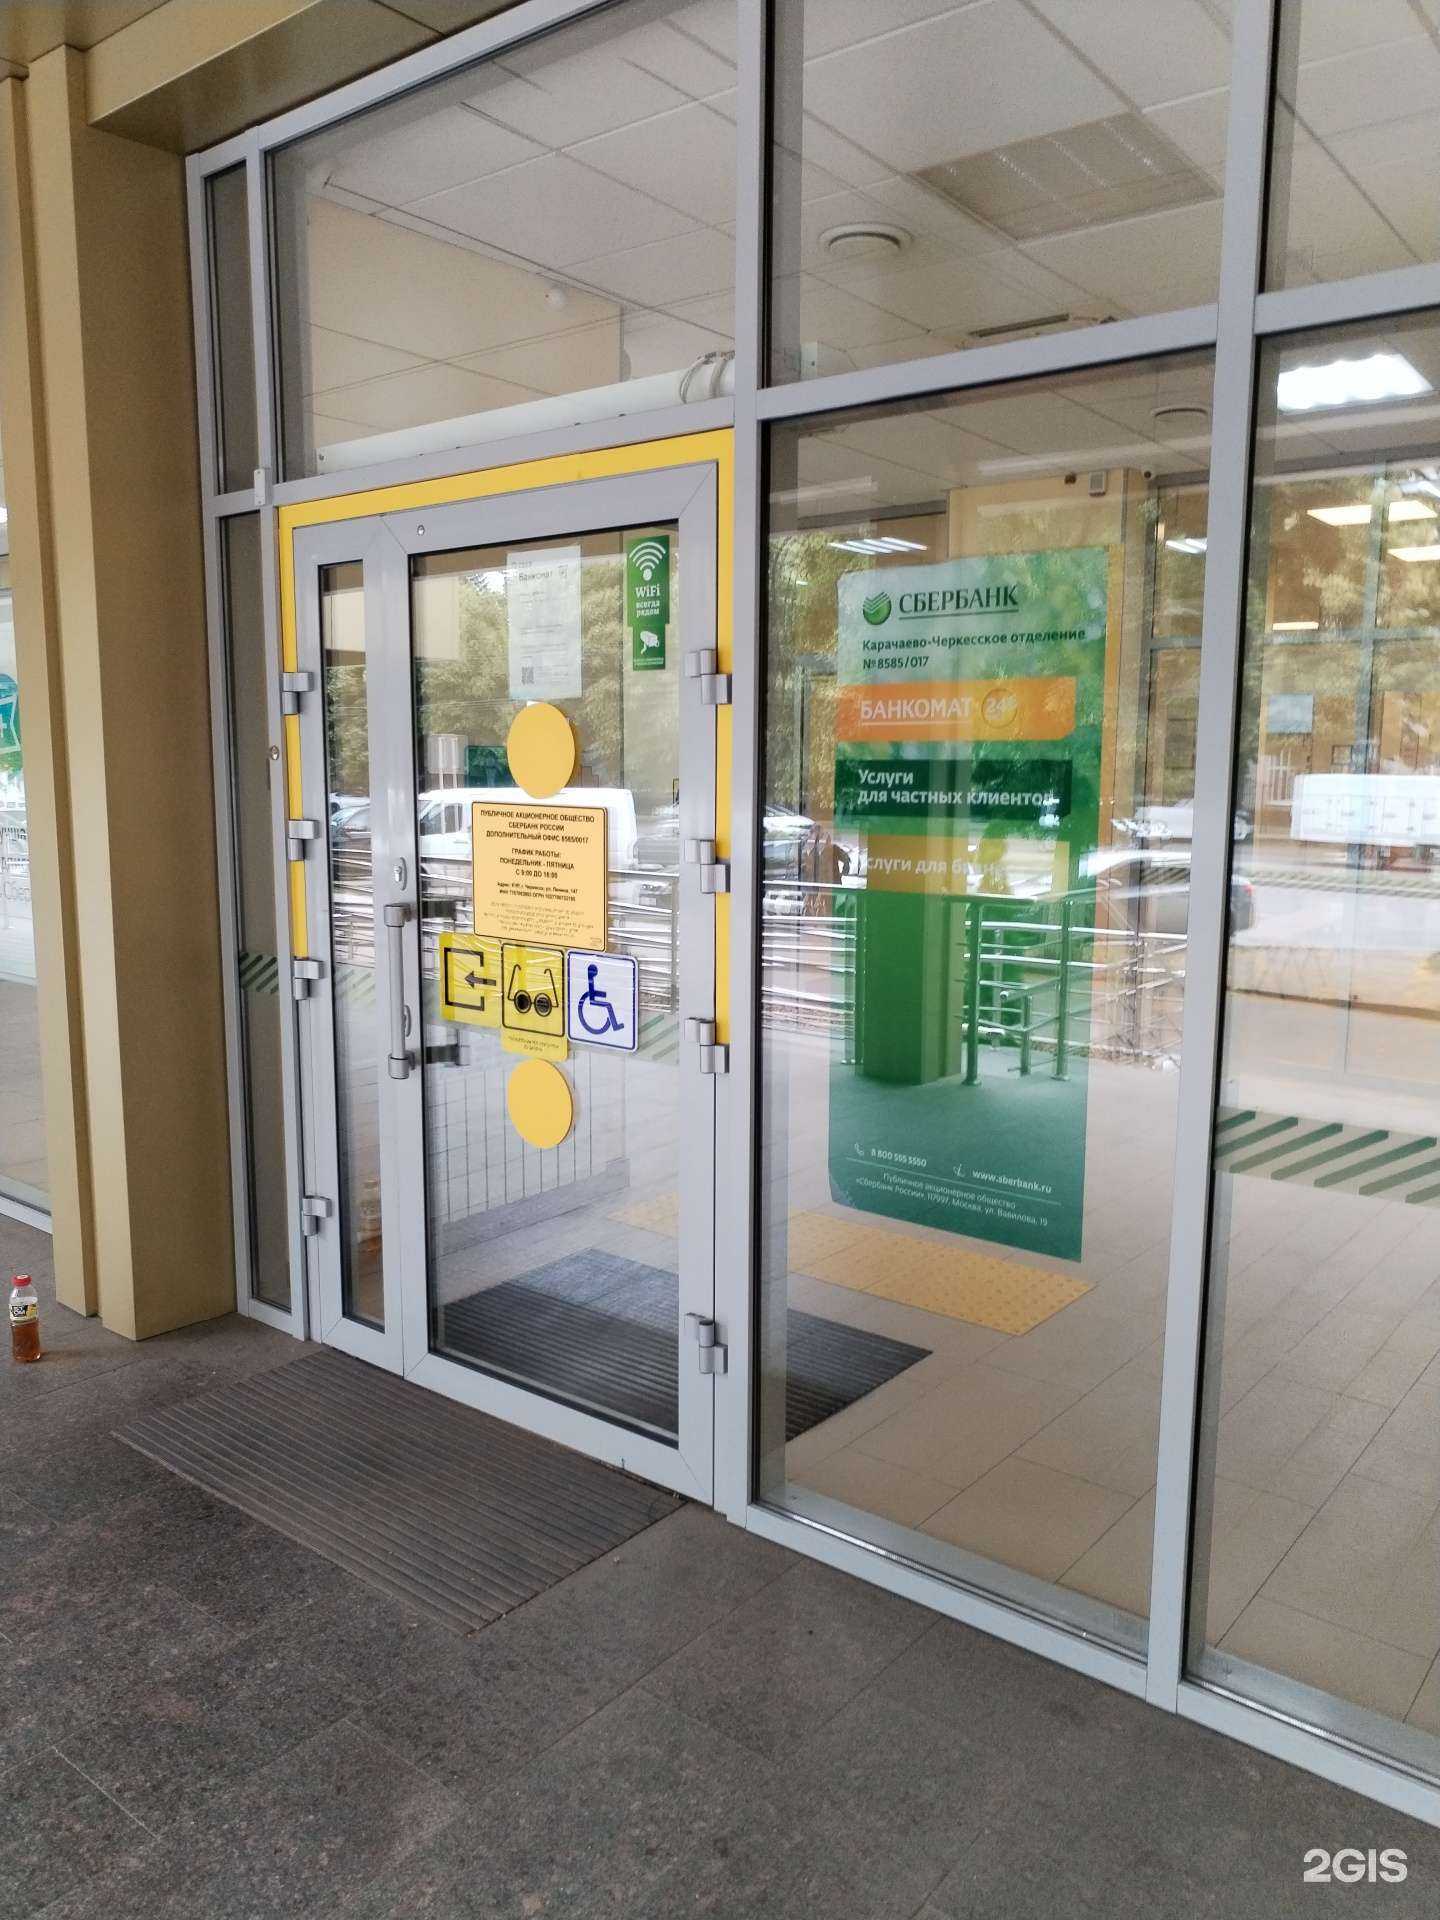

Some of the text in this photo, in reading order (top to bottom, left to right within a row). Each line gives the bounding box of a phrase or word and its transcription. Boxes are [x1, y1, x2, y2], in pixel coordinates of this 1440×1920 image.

[635, 584, 660, 598] WiFi
[898, 585, 1019, 614] СБЕРБАНК
[862, 629, 1086, 652] Карачаево-Черкесское отделение
[860, 697, 973, 720] БАНКОМАТ
[857, 769, 914, 788] Услуги
[857, 789, 888, 806] для
[890, 790, 963, 805] частных
[480, 809, 595, 823] ПУБЛИЧНОЕ АКЦИОНЕРНОЕ ОБЩЕСТВО
[508, 821, 565, 832] СБЕРБАНК РОССИИ
[486, 830, 542, 841] ДОПОЛНИТЕЛЬНЫЙ
[542, 834, 560, 842] ОФИС
[511, 847, 533, 856] ГРАФИК
[499, 857, 542, 867] ПОНЕДЕЛЬНИК
[546, 860, 575, 870] ПЯТНИЦА
[865, 855, 912, 875] слуги
[915, 859, 947, 875] для
[533, 870, 542, 878] ДО
[972, 1169, 1052, 1194] www.sberbank.ru
